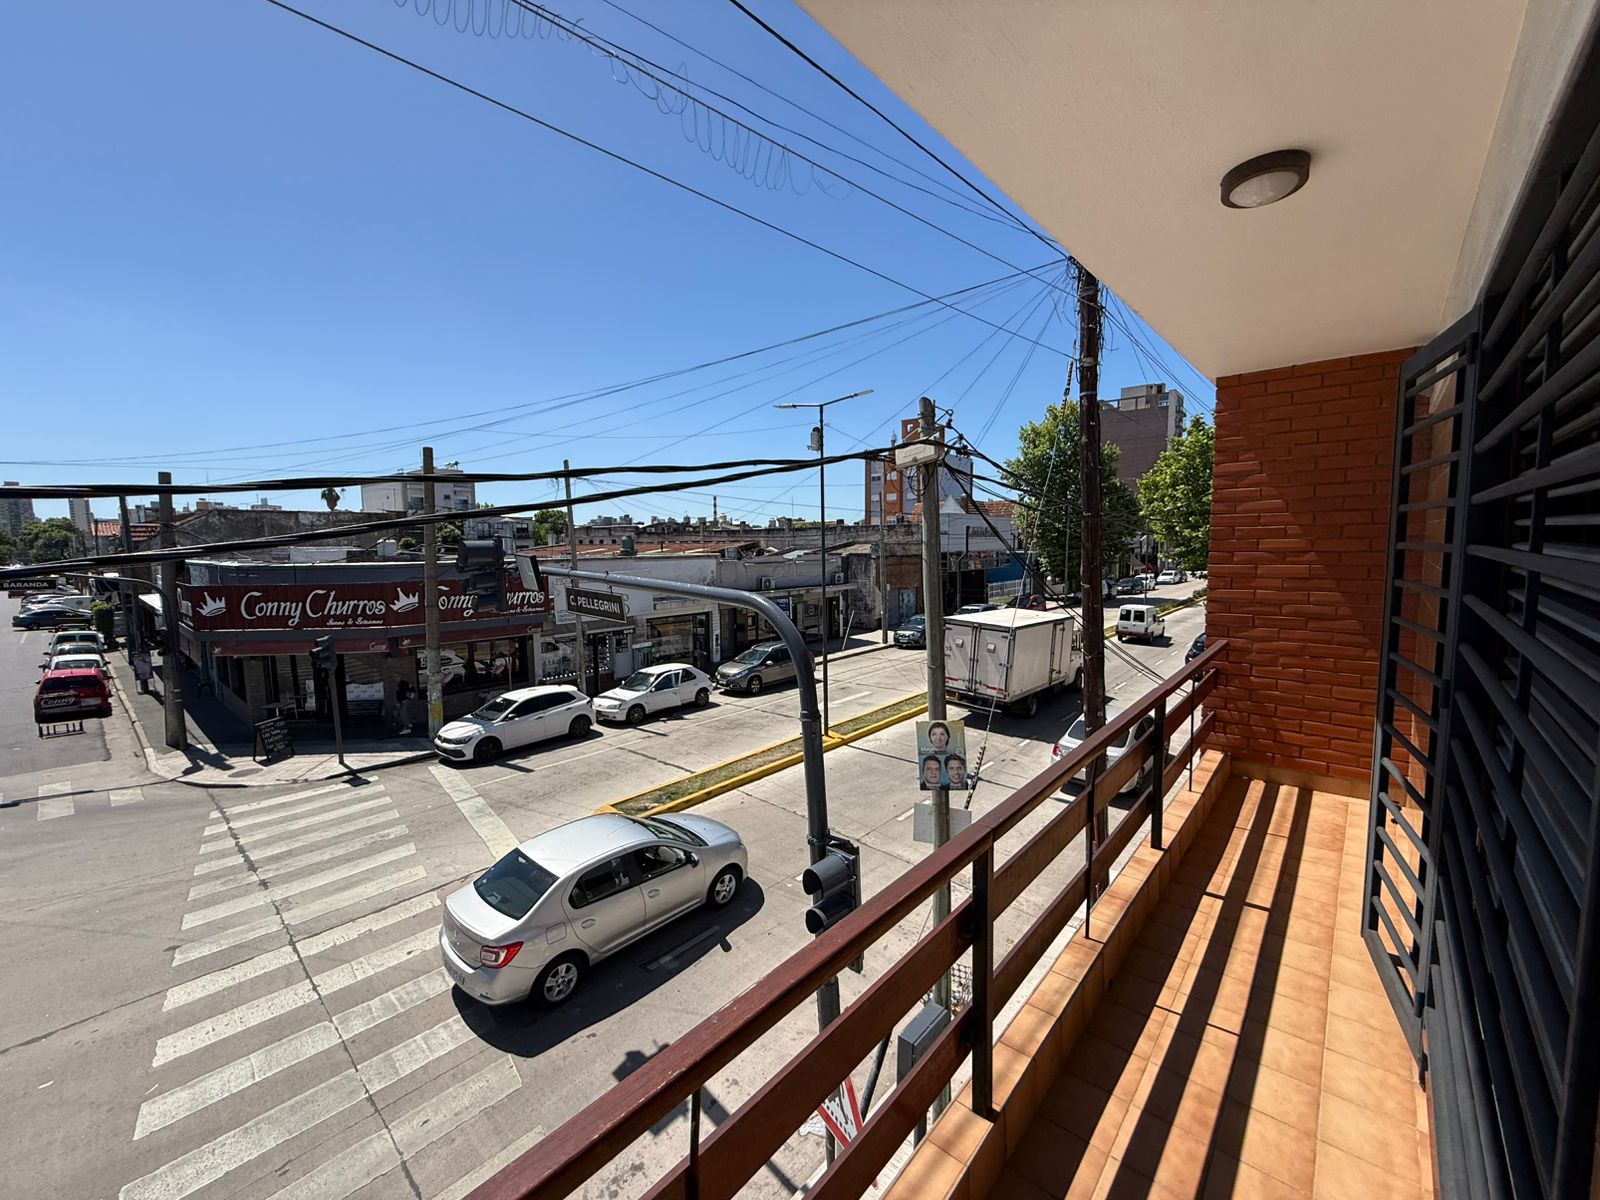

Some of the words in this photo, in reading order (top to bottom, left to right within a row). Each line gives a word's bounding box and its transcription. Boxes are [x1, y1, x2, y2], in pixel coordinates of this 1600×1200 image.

[240, 591, 302, 627] Conny
[305, 589, 386, 618] Churros
[437, 585, 479, 617] onny
[569, 595, 577, 606] C.
[577, 596, 621, 614] PELLEGRINI
